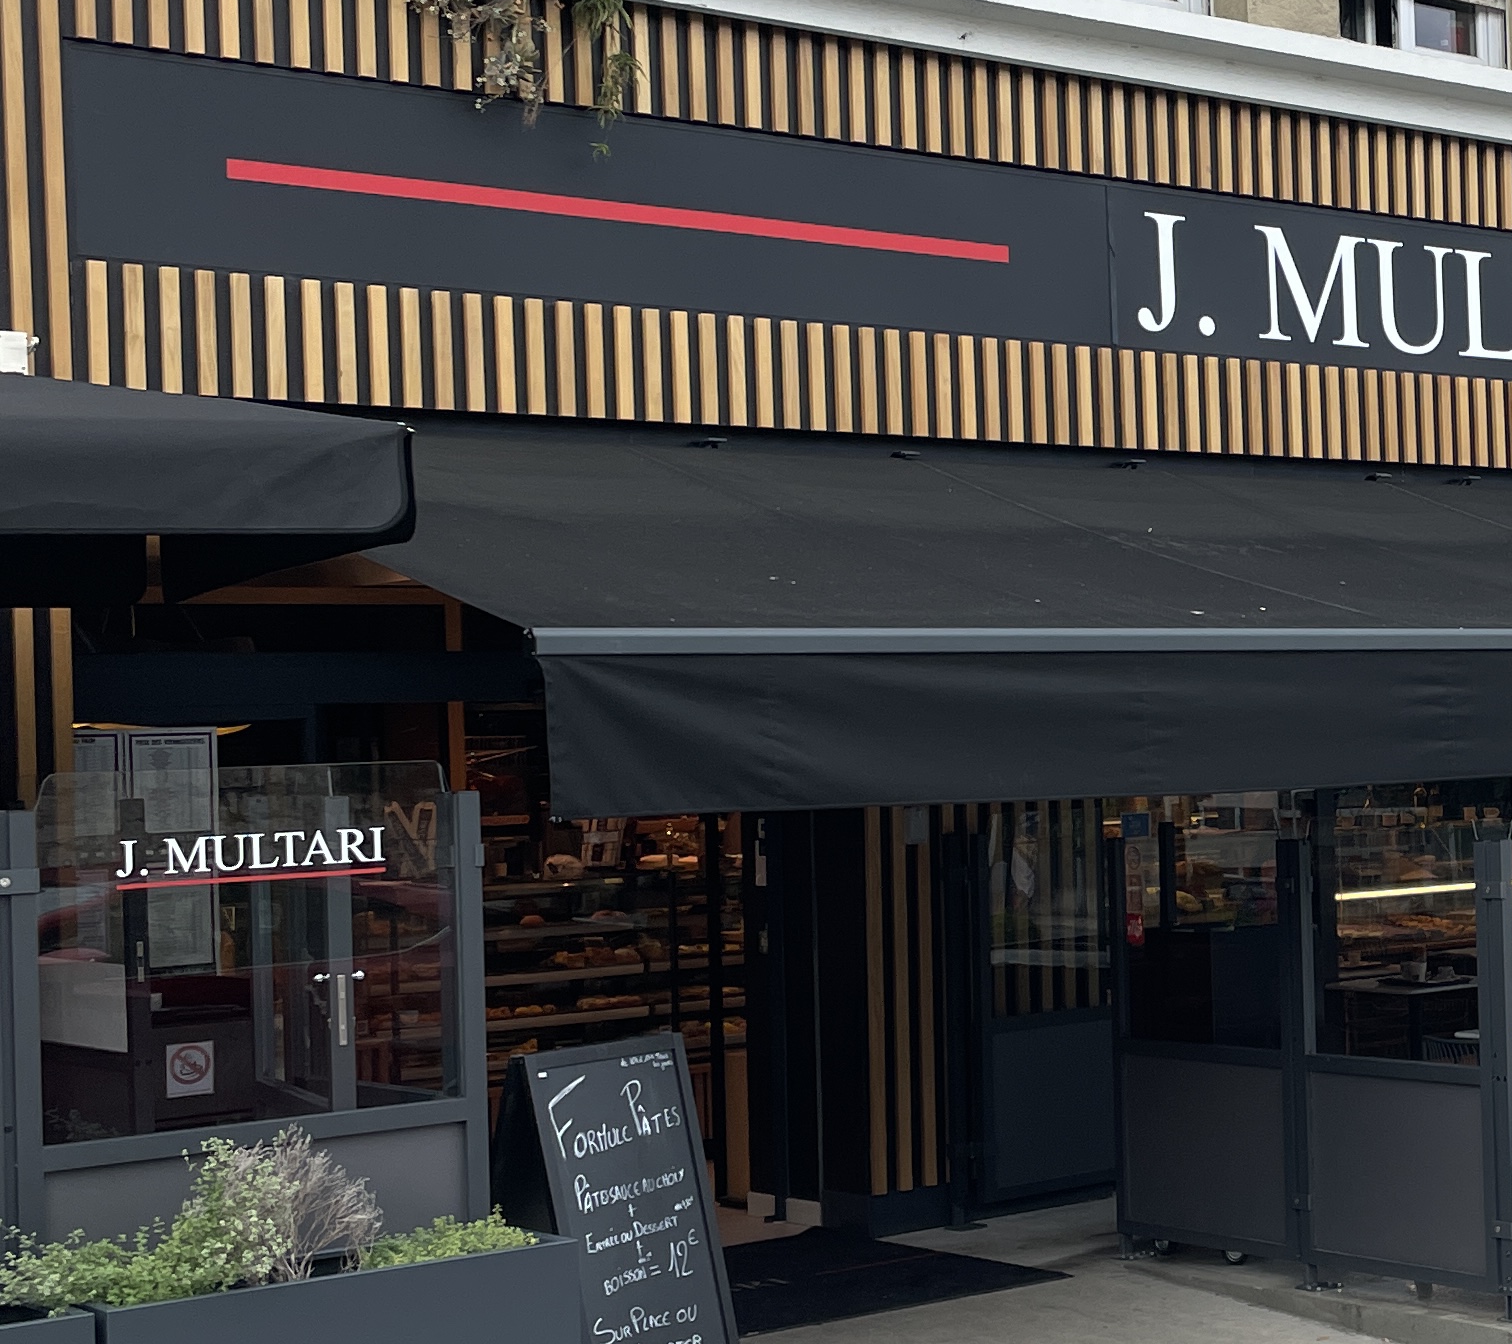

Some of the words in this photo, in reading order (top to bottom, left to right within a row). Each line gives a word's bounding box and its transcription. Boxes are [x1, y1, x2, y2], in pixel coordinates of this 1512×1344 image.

[1137, 211, 1216, 337] J.
[116, 840, 149, 878] J.
[162, 826, 387, 875] MULTARI
[548, 1074, 634, 1161] FORMULE
[620, 1079, 682, 1136] PÂTES
[632, 1215, 678, 1238] DESSERT
[629, 1306, 672, 1334] PLACE
[675, 1303, 698, 1324] OU
